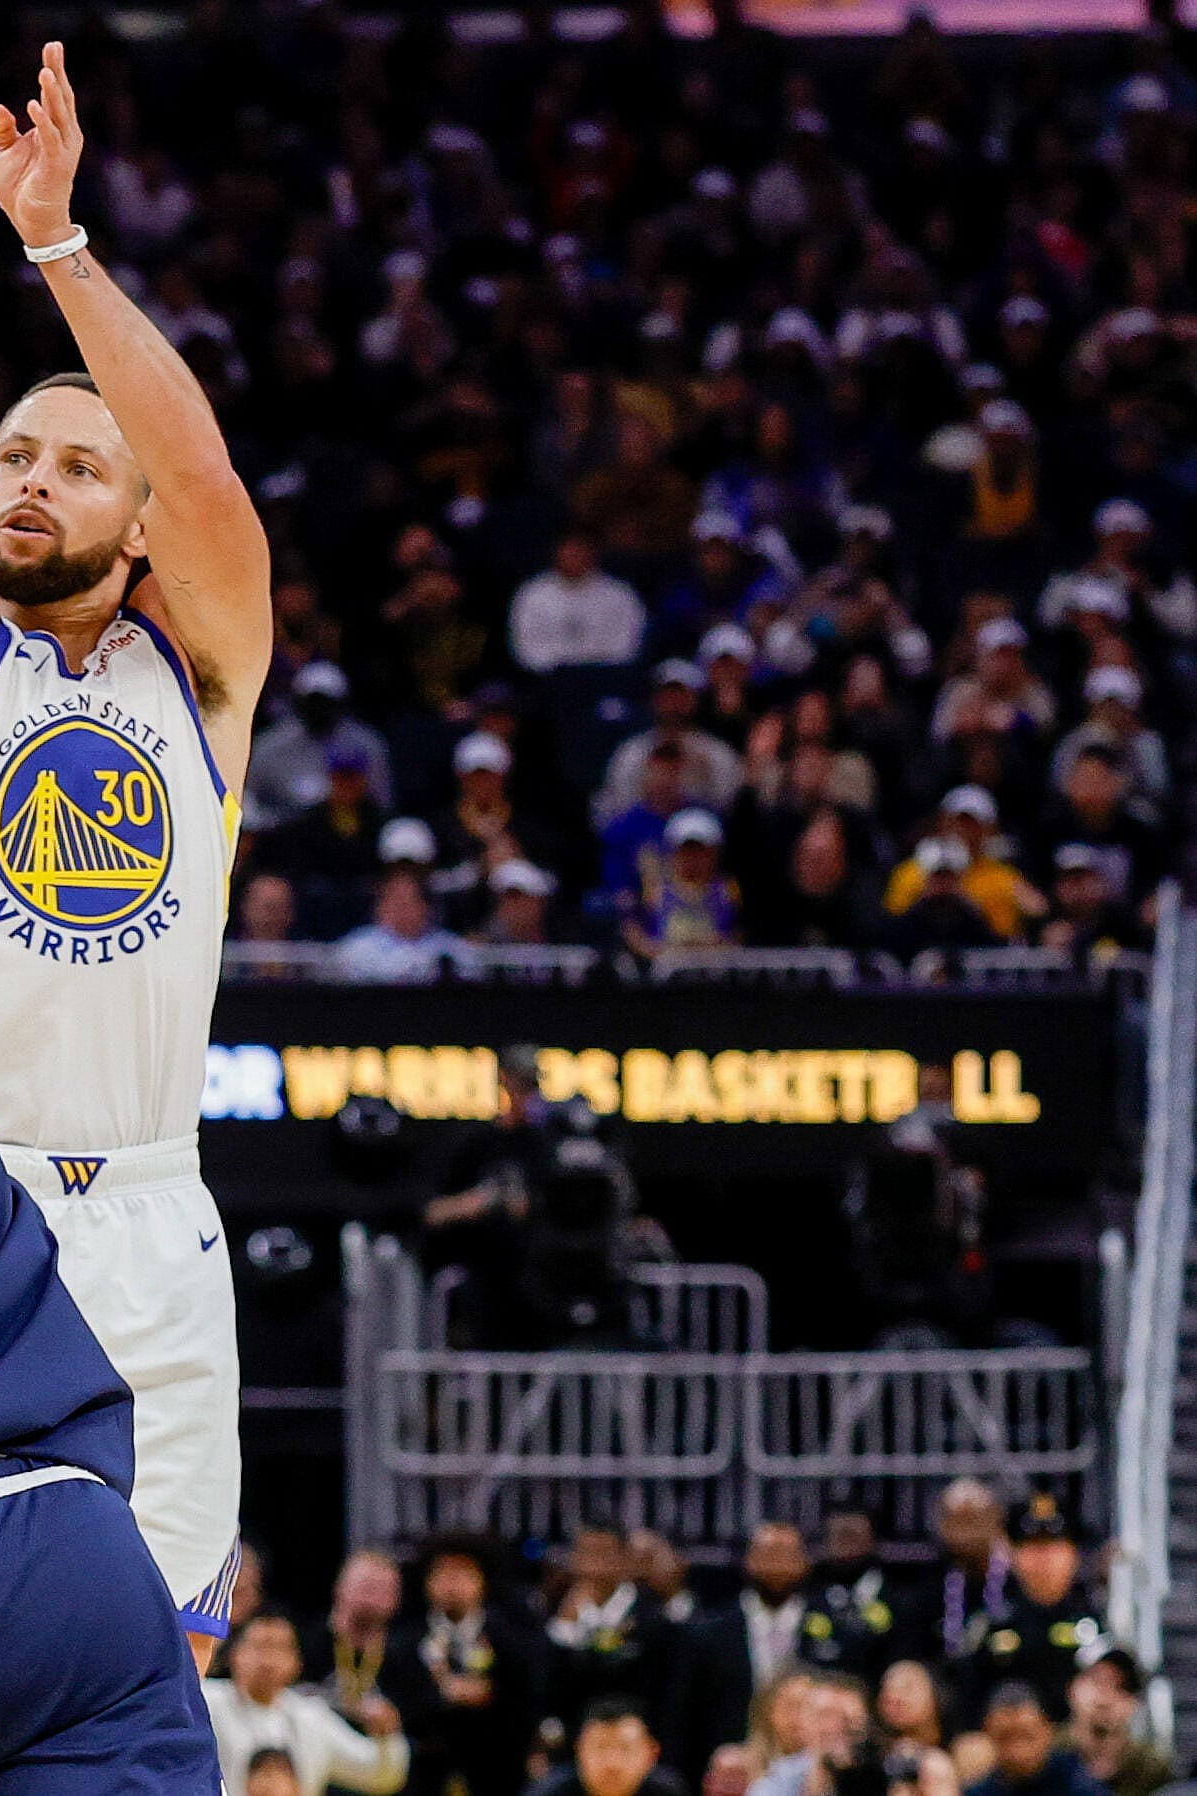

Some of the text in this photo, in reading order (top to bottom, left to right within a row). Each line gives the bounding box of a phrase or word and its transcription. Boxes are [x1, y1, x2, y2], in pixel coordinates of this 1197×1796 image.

[99, 701, 169, 758] STATE
[93, 769, 153, 827] 30
[282, 1045, 621, 1120] WARRIRS
[621, 1048, 1042, 1124] BASKETBLL
